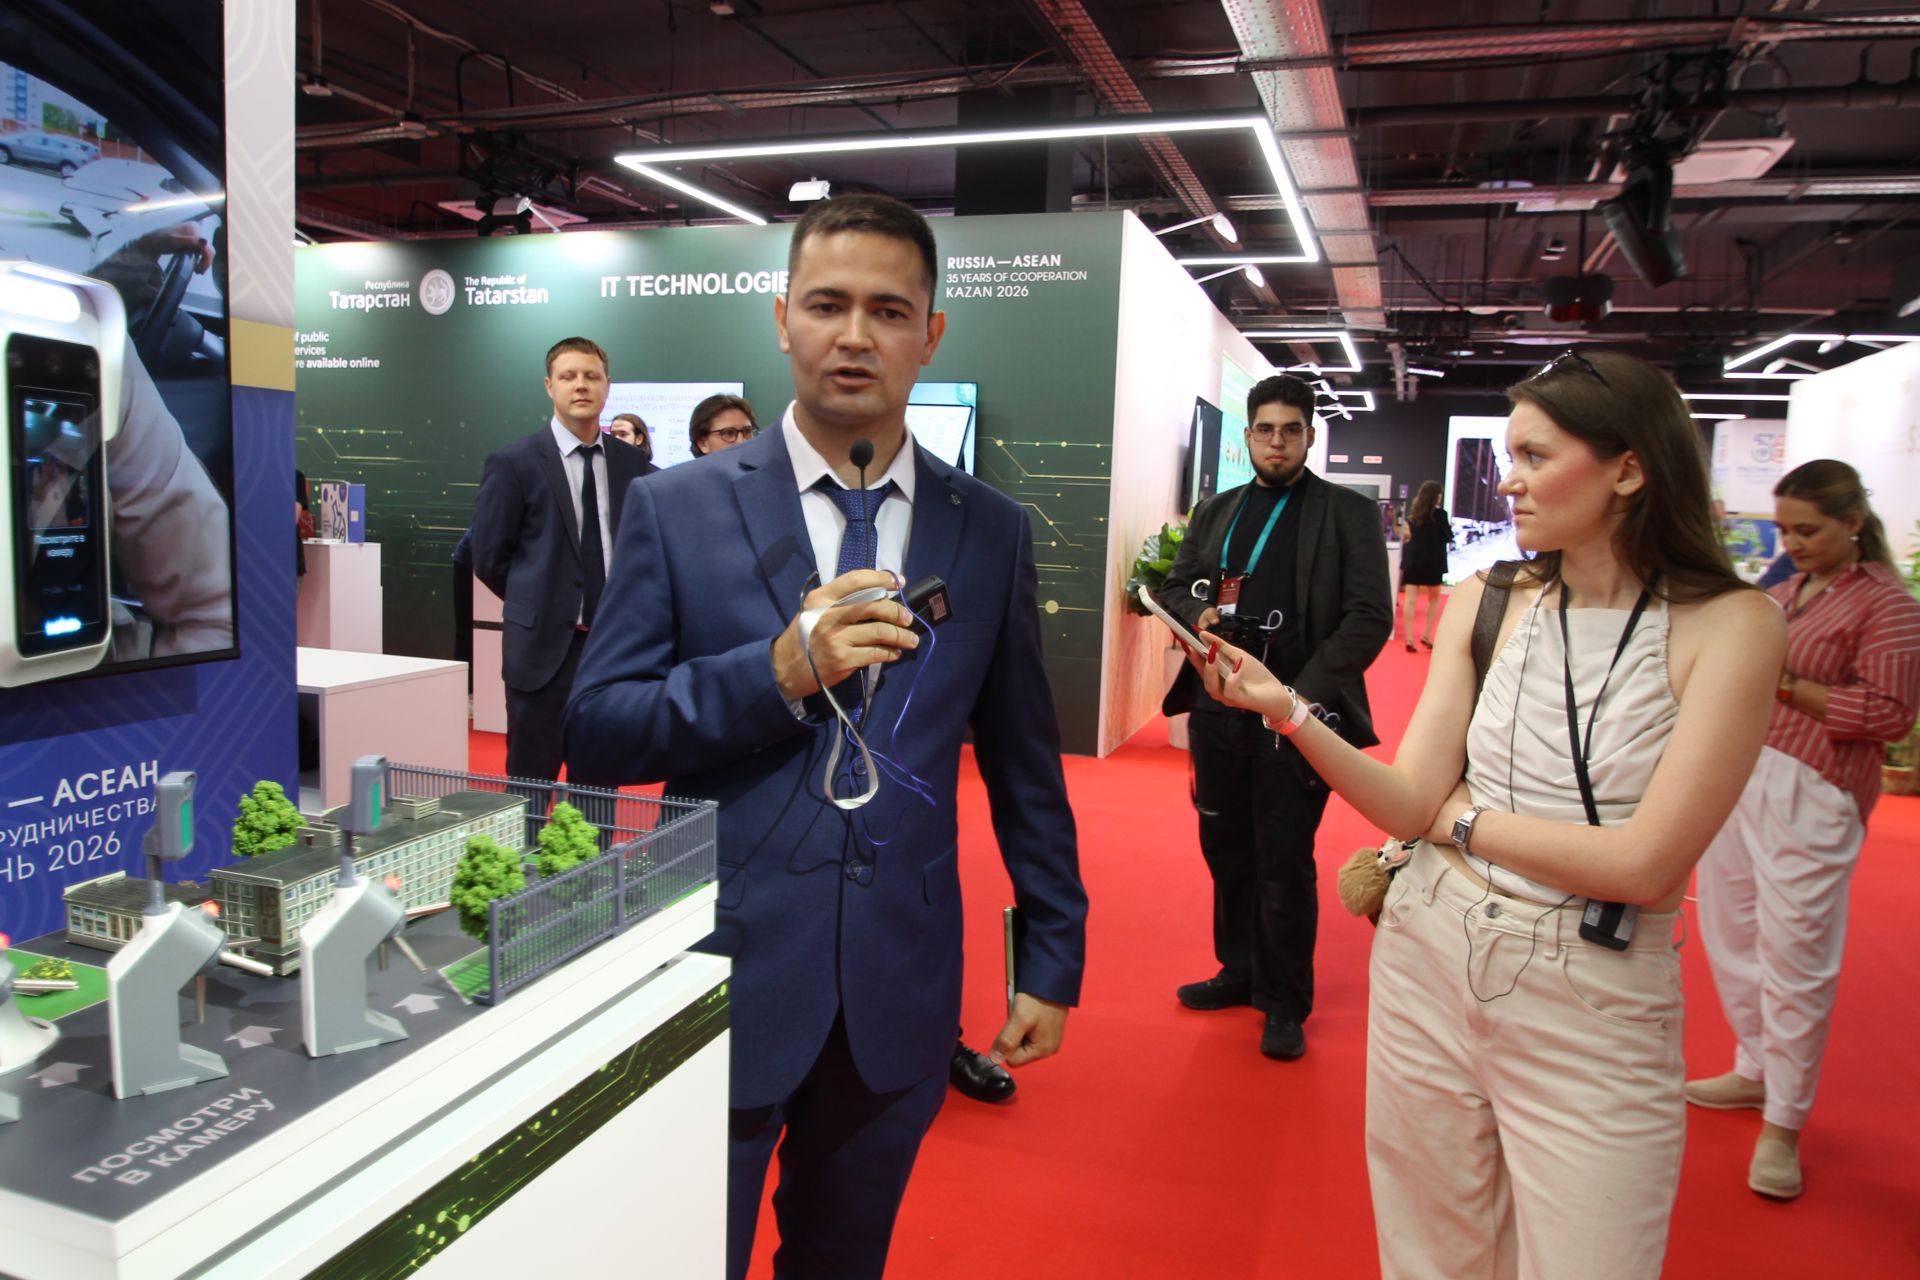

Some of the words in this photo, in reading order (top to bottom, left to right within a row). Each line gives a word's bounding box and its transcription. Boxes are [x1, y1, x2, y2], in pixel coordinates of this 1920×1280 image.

[464, 276, 479, 286] The
[480, 275, 515, 287] Republic
[516, 274, 527, 285] of
[601, 276, 621, 298] IT
[626, 270, 789, 297] TECHNOLOGIE
[946, 273, 959, 283] 35
[960, 272, 992, 283] YEARS
[993, 272, 1009, 282] OF
[1010, 270, 1088, 282] COOPERATION
[364, 279, 410, 291] Республика
[946, 286, 993, 298] KAZAN
[996, 285, 1029, 298] 2026
[328, 290, 411, 313] Татарстан
[464, 286, 549, 306] Tatarstan
[301, 331, 330, 344] public
[294, 345, 327, 356] ervices
[295, 359, 305, 369] re
[306, 357, 348, 369] available
[349, 356, 381, 369] online
[52, 760, 159, 807] АСЕАН
[48, 831, 121, 872] 2026
[72, 1087, 262, 1183] ПОСМОТРИ
[114, 1169, 152, 1185] В
[148, 1098, 275, 1167] КАМЕРУ
